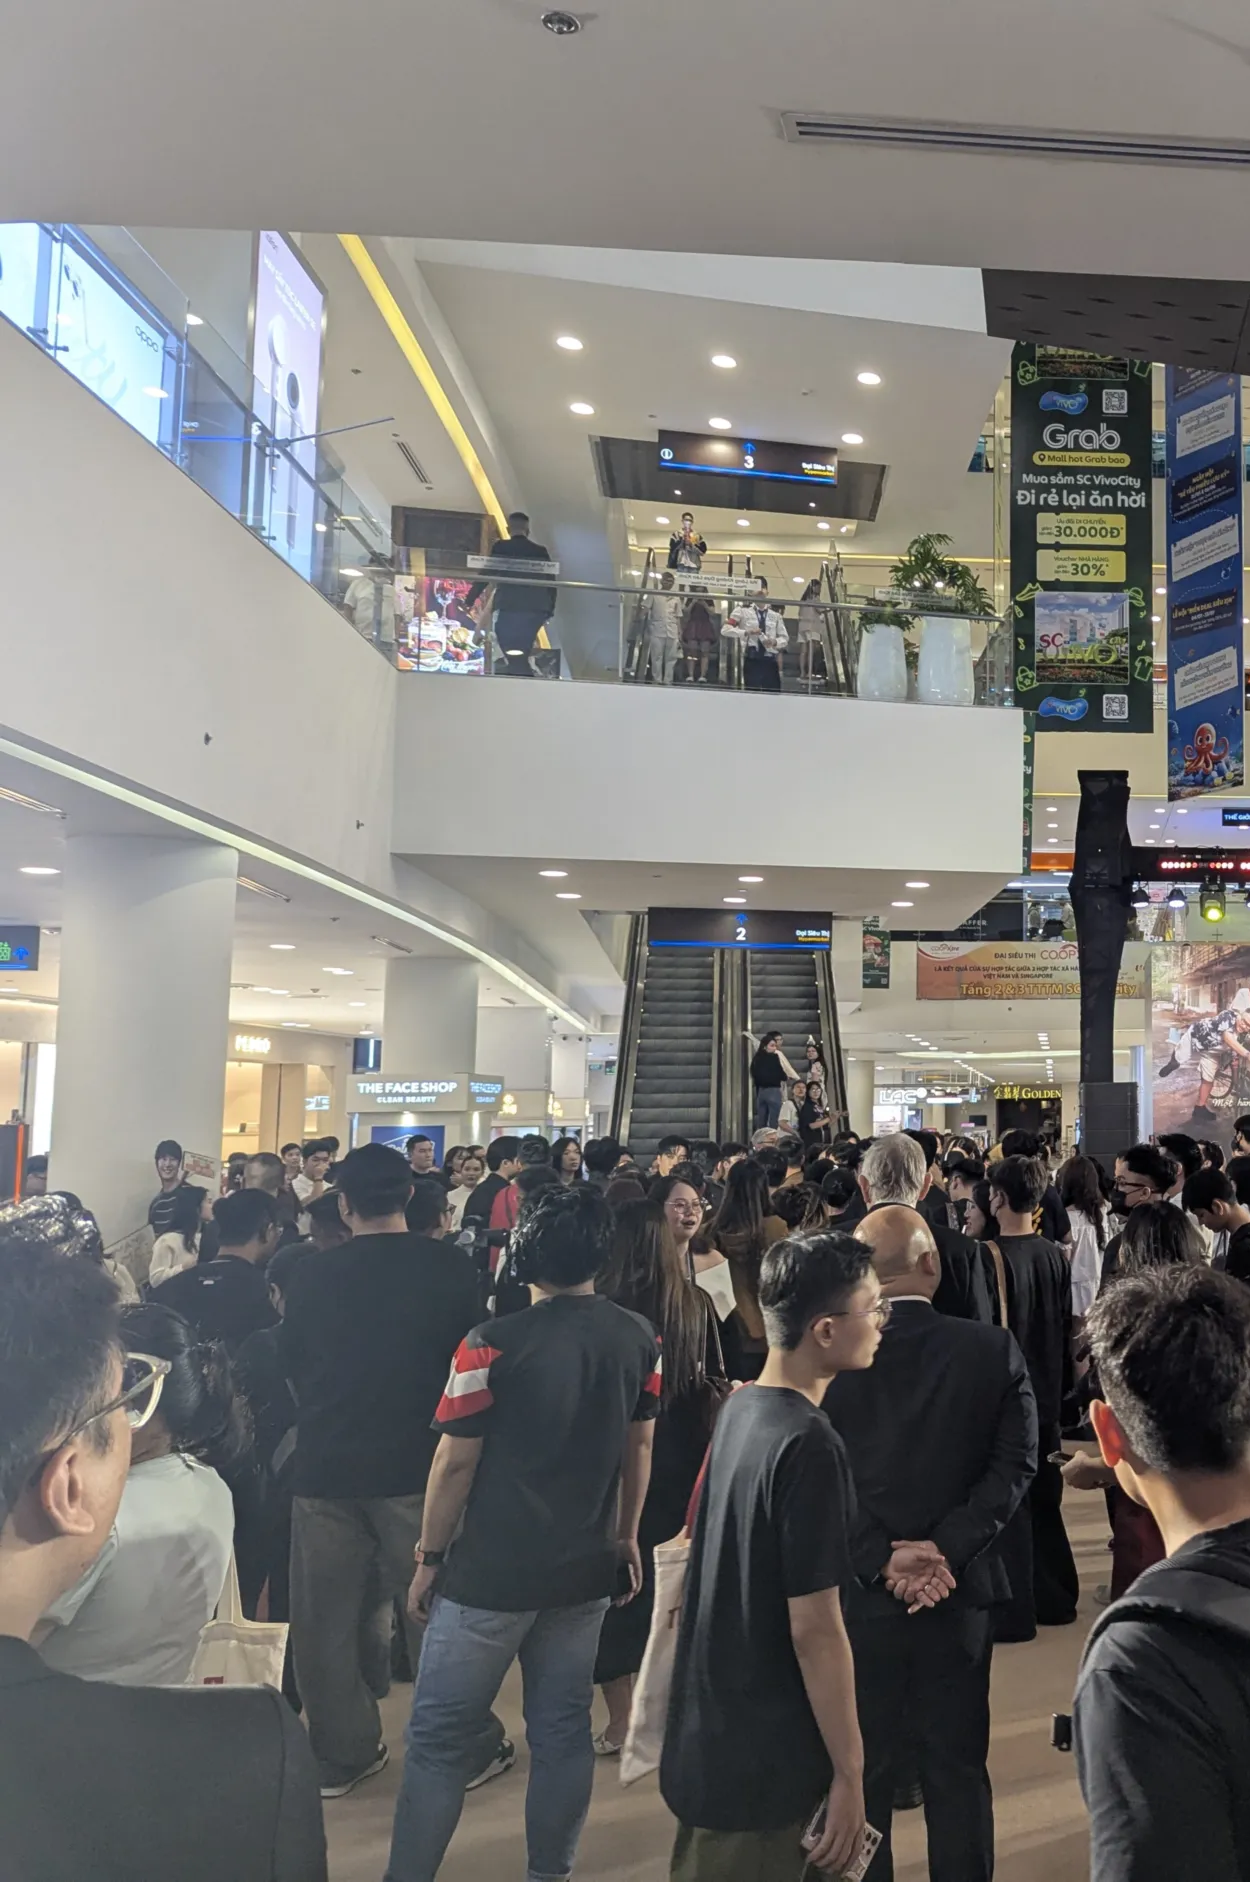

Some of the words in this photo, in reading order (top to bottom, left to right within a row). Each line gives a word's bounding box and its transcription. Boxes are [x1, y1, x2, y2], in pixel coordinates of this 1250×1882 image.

[1043, 423, 1121, 450] Grab
[744, 456, 754, 468] 3
[1047, 454, 1067, 463] Mall
[1069, 454, 1083, 463] hot
[1085, 455, 1107, 464] Grab
[1022, 473, 1048, 484] Mua
[1050, 472, 1074, 484] sắm
[1076, 474, 1091, 485] SC
[1093, 475, 1141, 489] VivoCity
[1016, 490, 1036, 505] Đi
[1040, 489, 1059, 506] rẻ
[1062, 490, 1086, 509] lại
[1089, 490, 1113, 507] ăn
[1117, 491, 1147, 508] hời
[1040, 633, 1063, 648] SC
[736, 928, 746, 940] 2
[994, 984, 1003, 996] 2
[1006, 984, 1015, 995] &
[1017, 984, 1026, 995] 3
[1027, 984, 1064, 995] TTTM
[357, 1083, 384, 1094] THE
[385, 1082, 420, 1094] FACE
[421, 1081, 457, 1093] SHOP
[1022, 1088, 1062, 1099] GOLDEN
[405, 1095, 436, 1103] BEAUTY
[1212, 1098, 1234, 1107] Một
